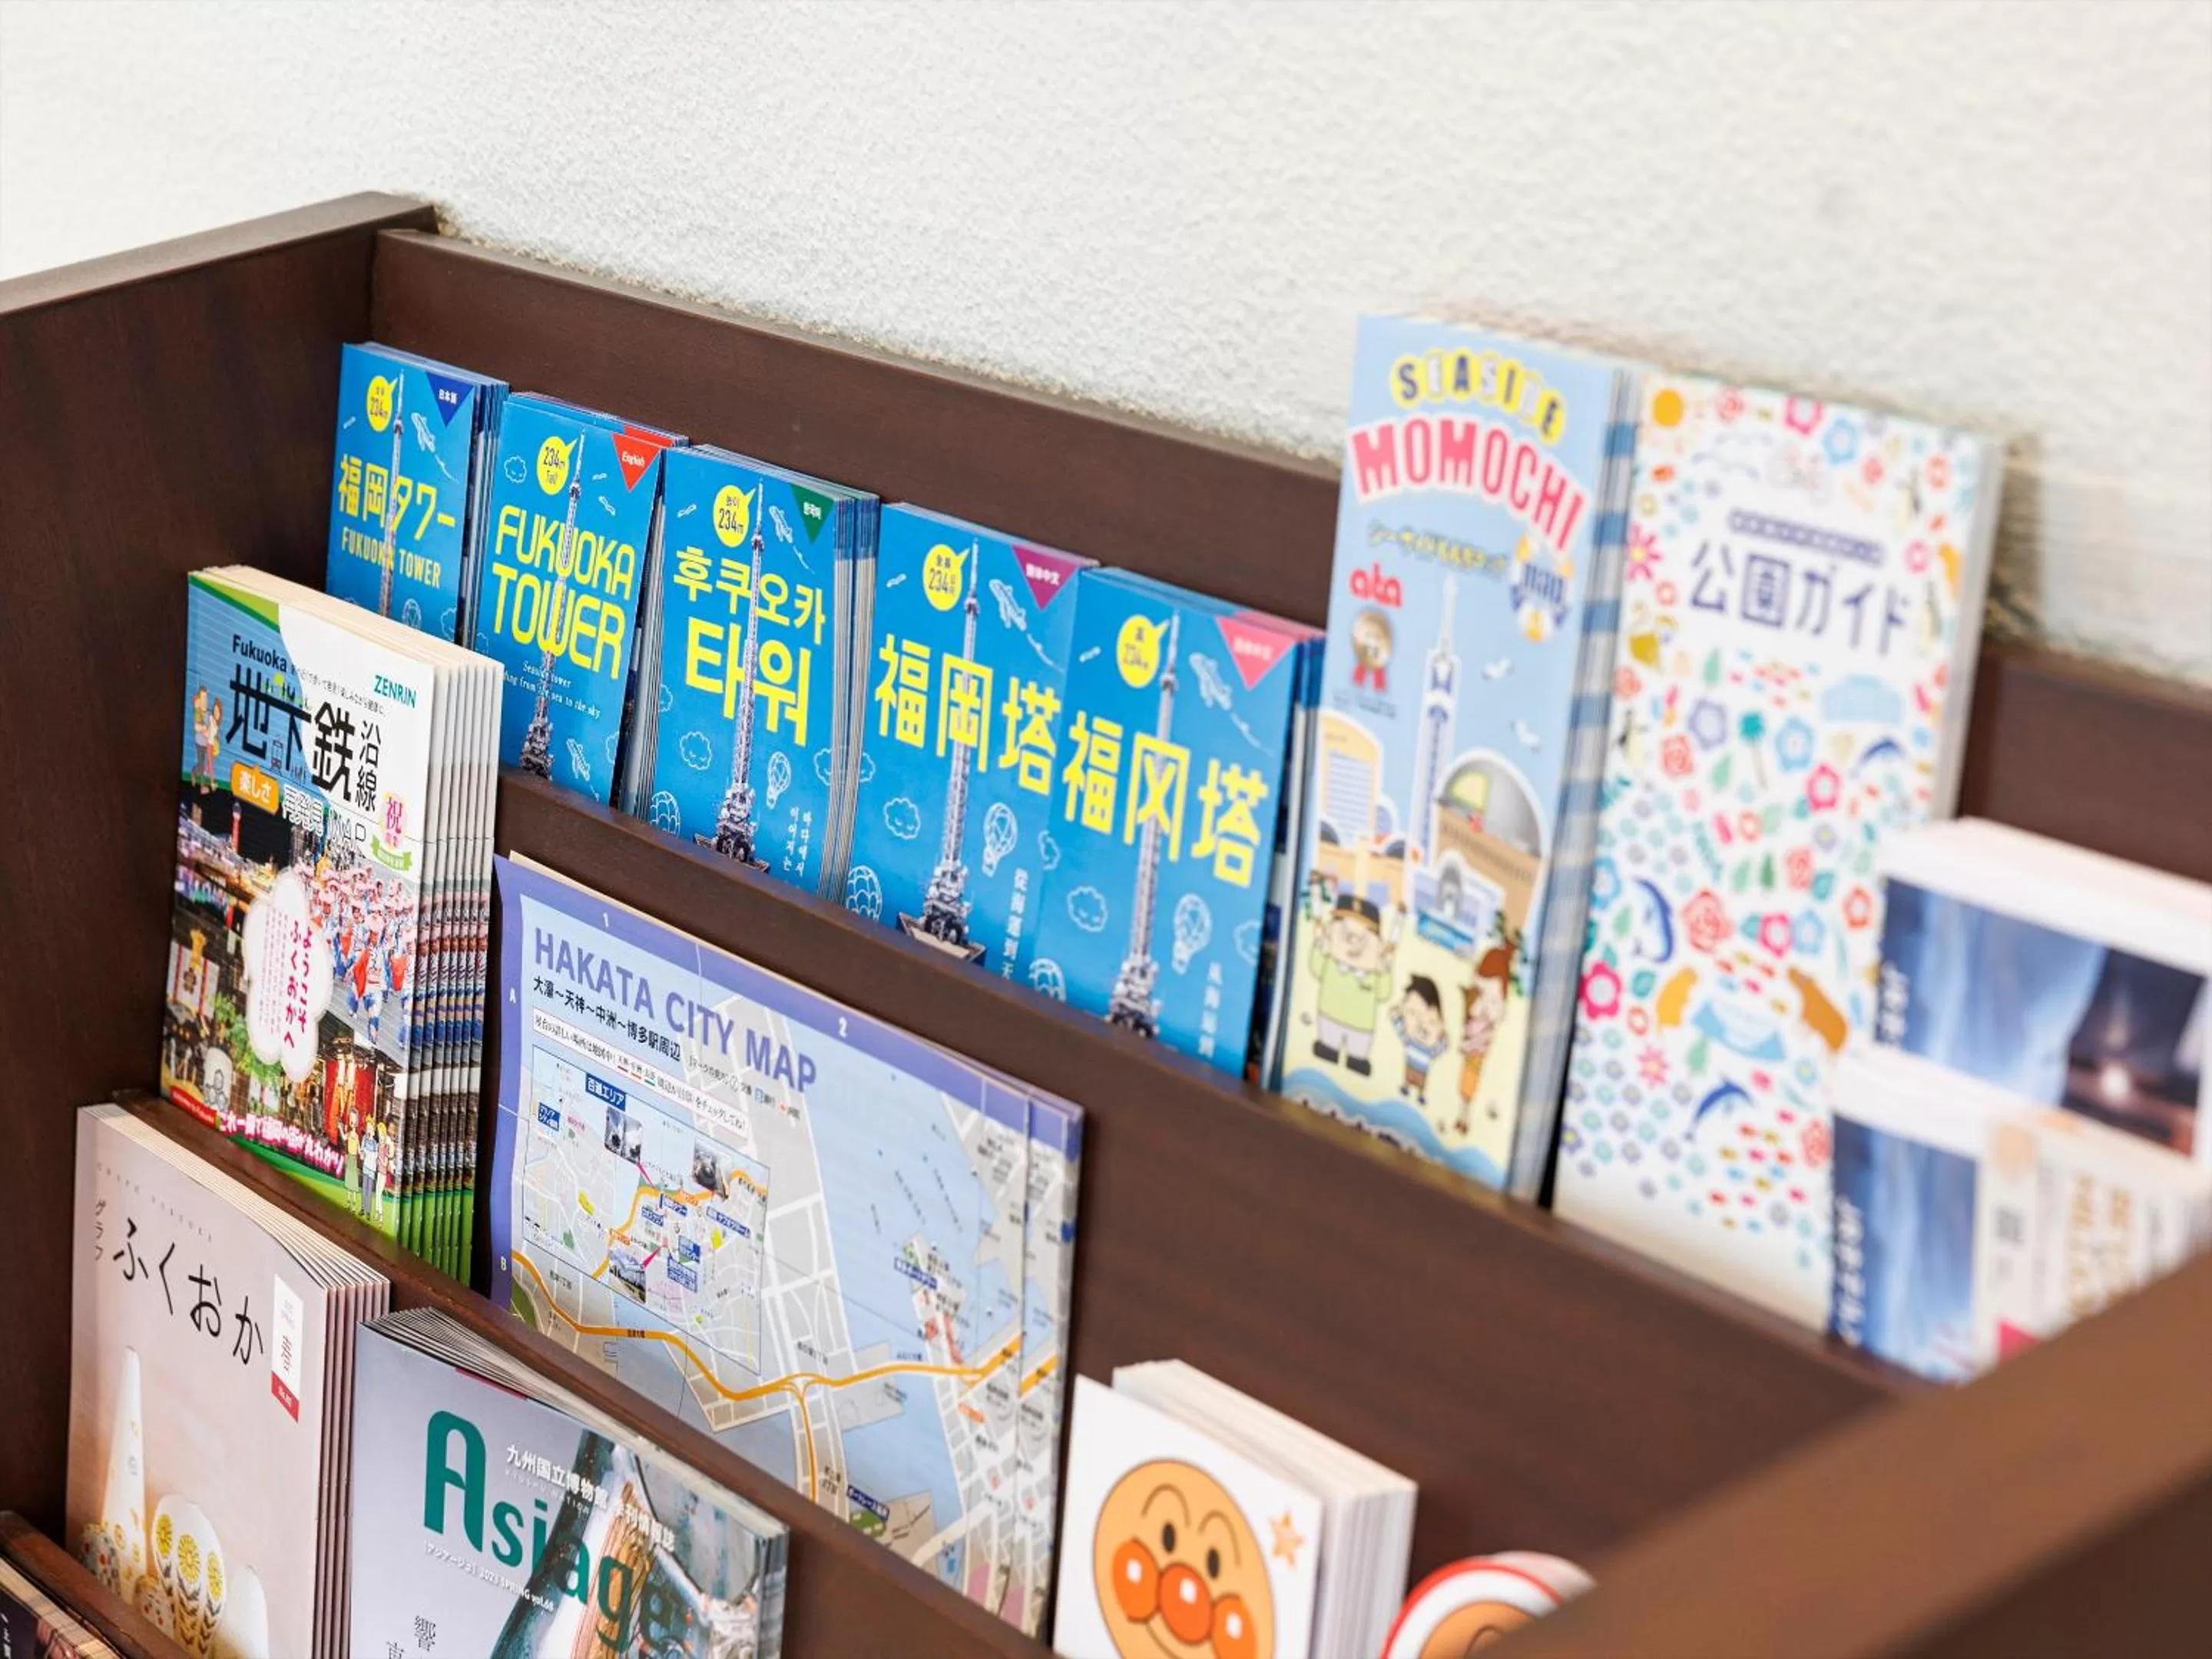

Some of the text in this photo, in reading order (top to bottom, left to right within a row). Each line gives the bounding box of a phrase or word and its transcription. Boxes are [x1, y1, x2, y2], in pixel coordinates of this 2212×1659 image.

[1394, 351, 1562, 442] SEASIDE
[338, 454, 455, 541] 福岡タワー
[621, 451, 645, 467] English
[1352, 418, 1583, 551] MOMOCHI
[342, 527, 441, 590] FUKUOKA TOWER
[495, 505, 636, 601] FUKUOKA
[674, 546, 826, 646] 후쿠오카
[1690, 539, 1913, 655] 公園ガイド
[232, 634, 289, 673] Fukuoka
[492, 562, 626, 680] TOWER
[374, 674, 417, 709] ZENRIN
[686, 616, 811, 747] 타워
[875, 633, 1061, 796] 福岡塔
[226, 663, 356, 802] 地下鉄
[356, 720, 381, 813] 沿線
[240, 771, 272, 804] 楽しさ
[1062, 709, 1269, 889] 福冈塔
[535, 927, 654, 1020] HAKATA
[666, 992, 735, 1055] CITY
[746, 1028, 817, 1094] MAP
[839, 1017, 848, 1038] 2
[113, 1217, 263, 1365] ふくおか
[424, 1410, 693, 1654] Asiage
